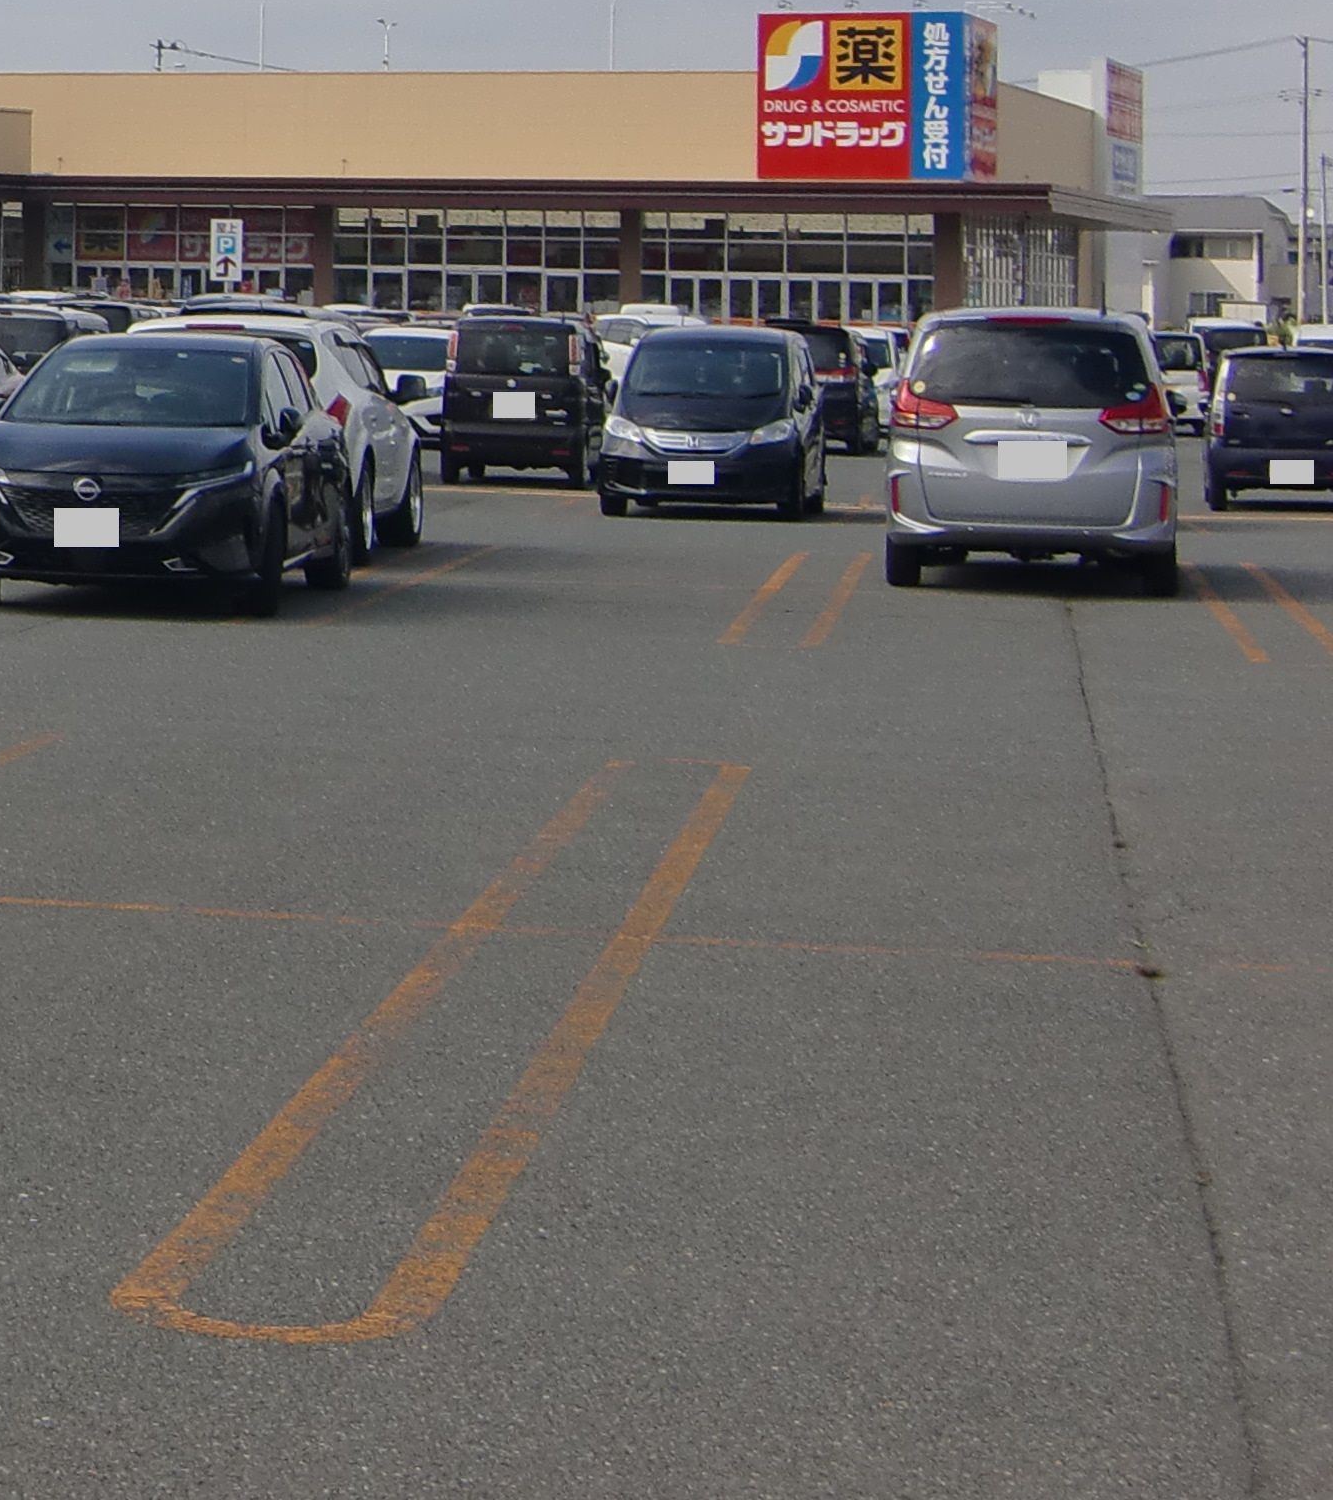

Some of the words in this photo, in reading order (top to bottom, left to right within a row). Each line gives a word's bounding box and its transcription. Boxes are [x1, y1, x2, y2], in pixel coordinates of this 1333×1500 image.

[835, 26, 896, 85] 薬
[764, 100, 808, 113] DRUG
[811, 100, 823, 113] &
[825, 100, 905, 114] COSMETIC
[923, 21, 950, 170] 処方せん受付
[761, 120, 907, 148] サンドラッグ
